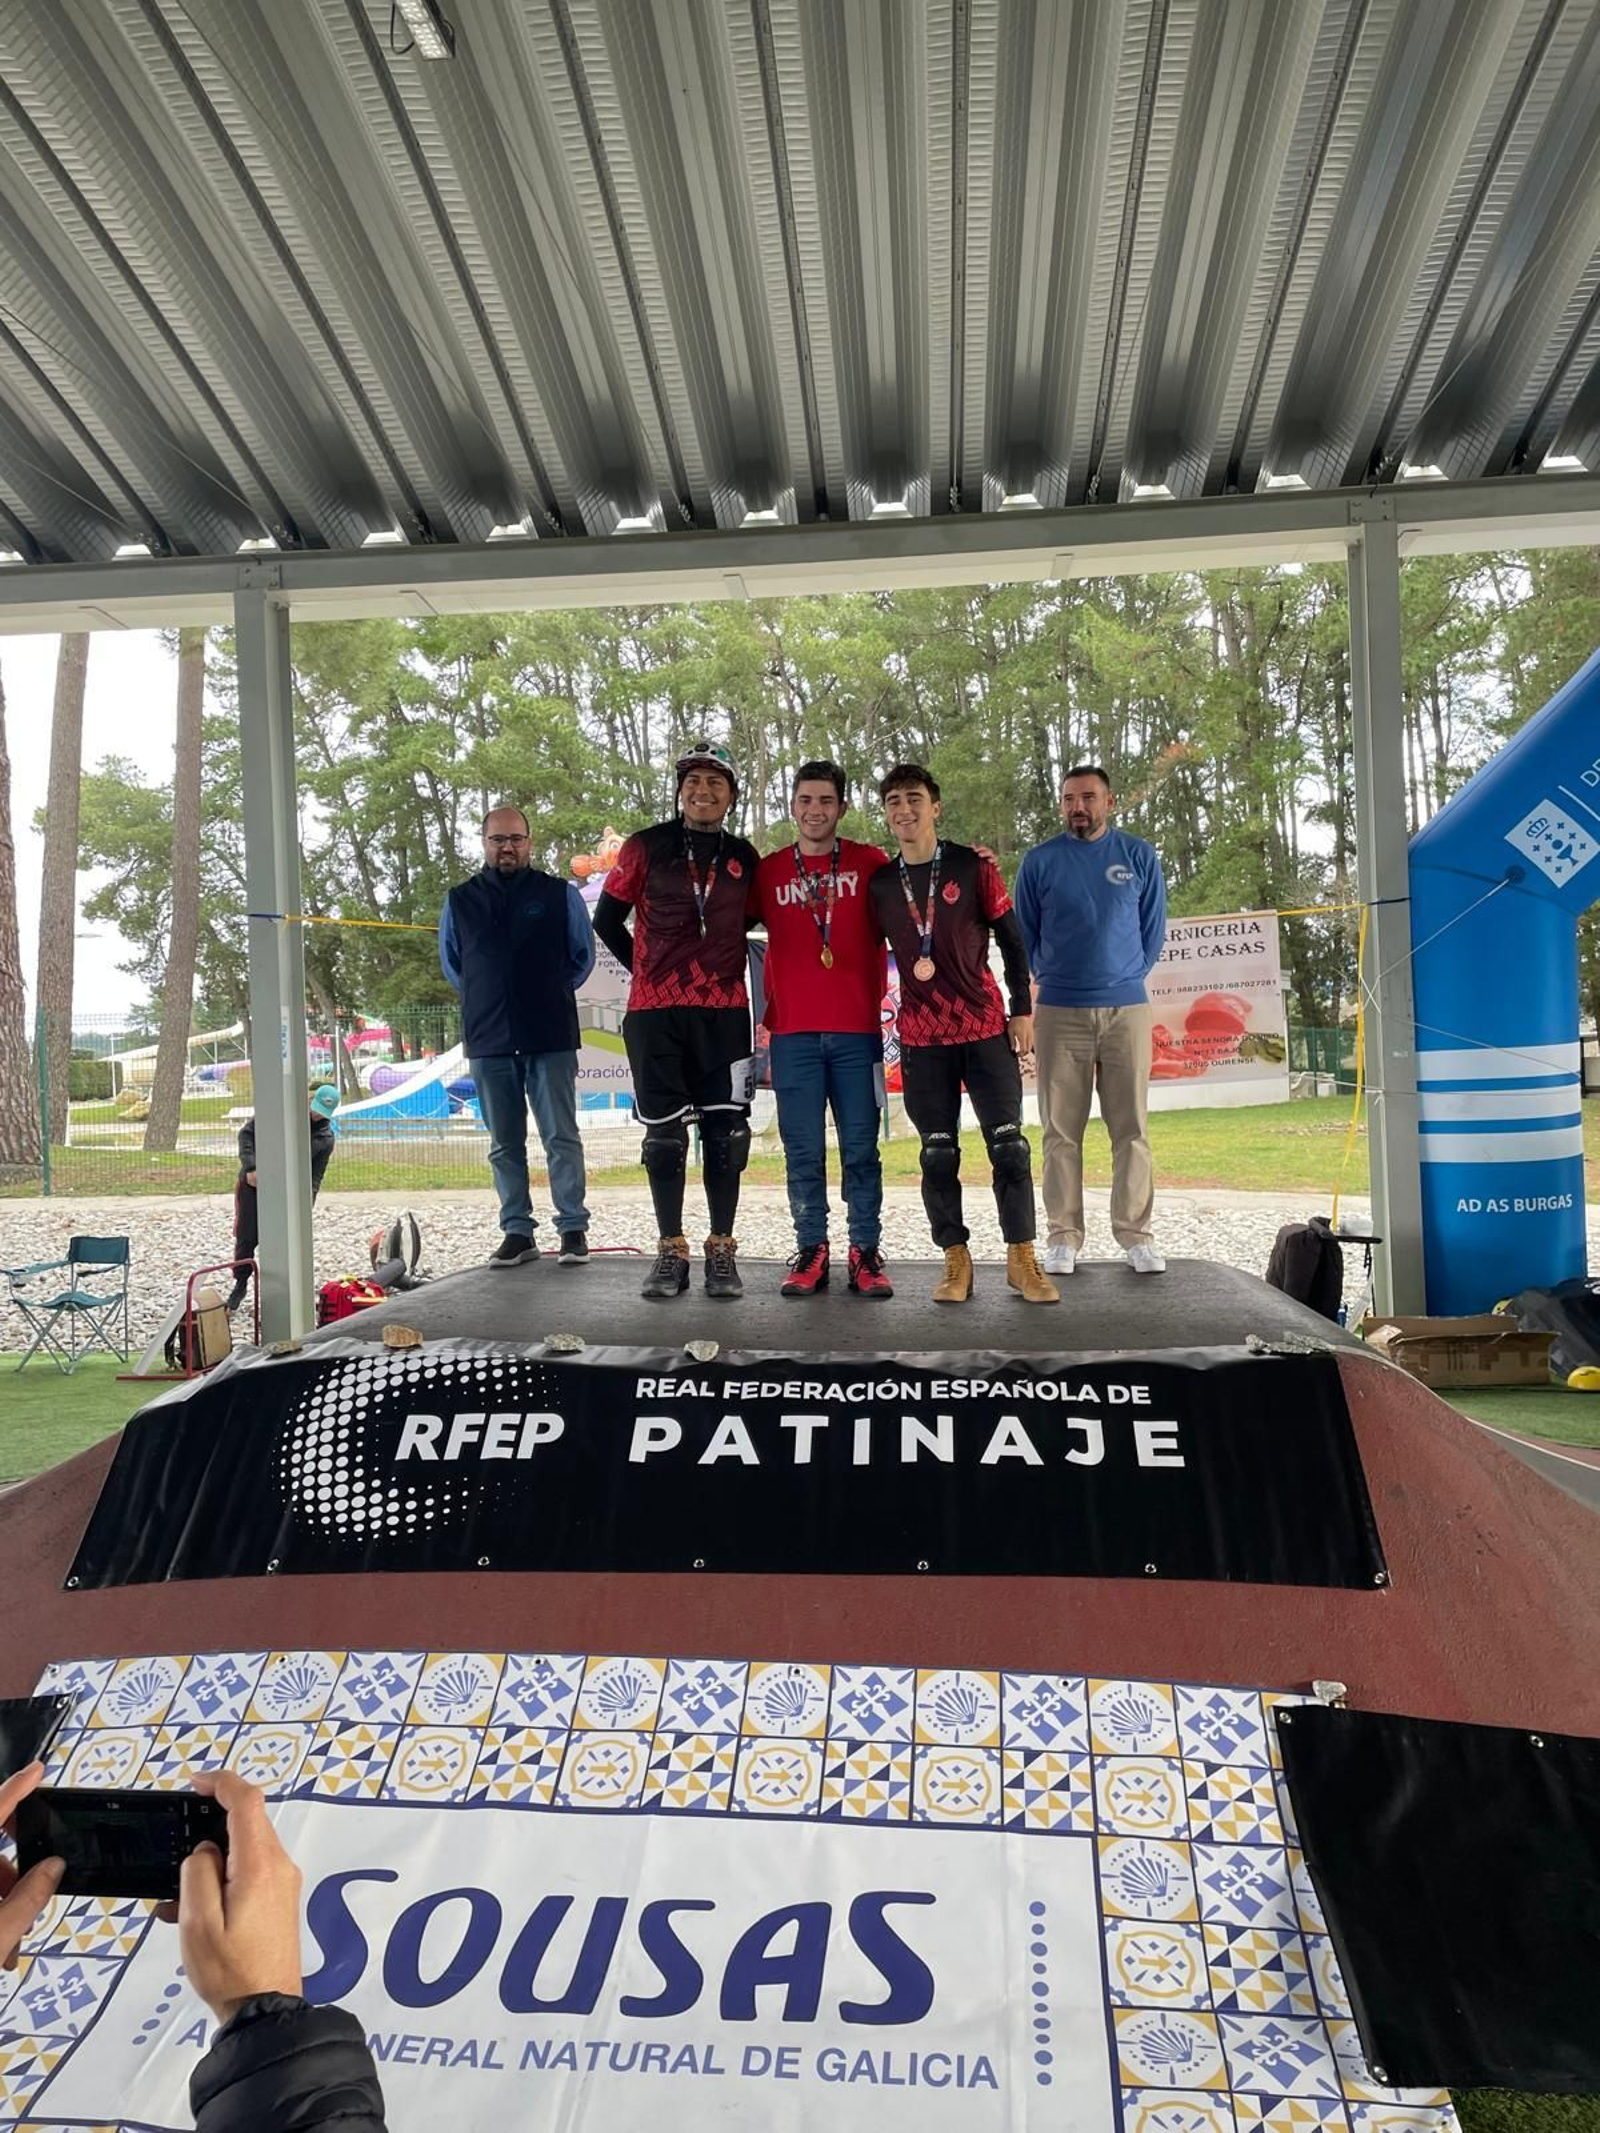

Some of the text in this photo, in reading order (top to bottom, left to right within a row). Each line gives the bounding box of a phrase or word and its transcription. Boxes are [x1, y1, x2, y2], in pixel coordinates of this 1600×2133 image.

[1197, 940, 1266, 958] CASAS
[1457, 1194, 1573, 1213] AD AS BURGAS
[636, 1378, 1152, 1404] REAL FEDERACIÓN ESPAÑOLA DE
[394, 1412, 565, 1461] RFEP
[628, 1414, 1186, 1468] PATINAJE
[303, 1868, 937, 2025] SOUSAS
[518, 2039, 726, 2076] NATURAL
[741, 2045, 803, 2079] DE
[815, 2046, 1000, 2090] GALICIA
